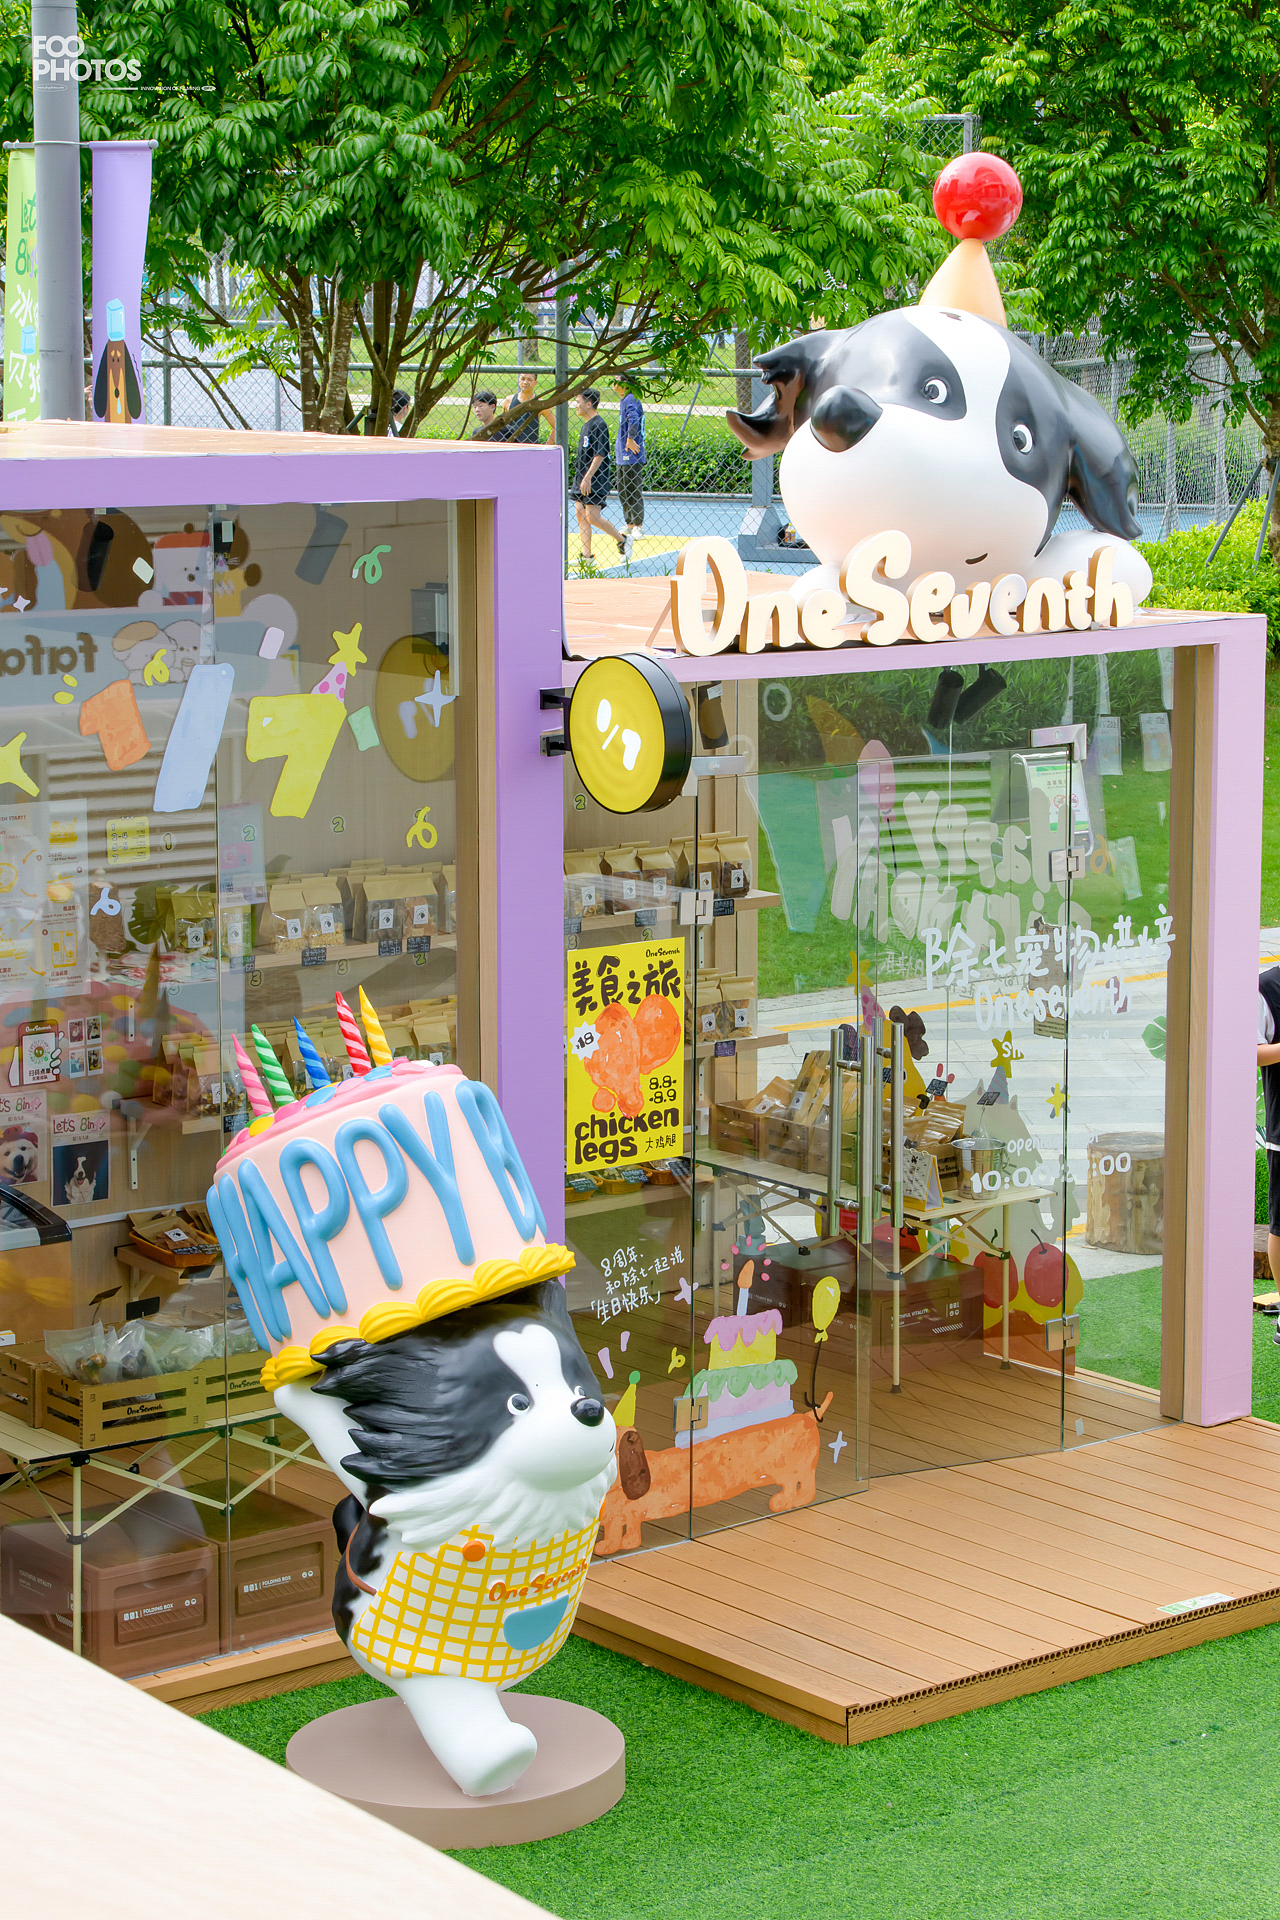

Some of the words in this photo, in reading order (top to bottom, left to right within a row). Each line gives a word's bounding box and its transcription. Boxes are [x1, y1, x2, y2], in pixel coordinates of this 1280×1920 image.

[332, 816, 345, 833] 2
[163, 833, 172, 850] 1
[243, 825, 256, 842] 2
[337, 959, 348, 975] 3
[250, 970, 262, 987] 3
[572, 955, 681, 1016] 美食之旅
[574, 1107, 680, 1141] chicken
[575, 1136, 638, 1165] legs
[206, 1091, 476, 1351] HAPPY
[262, 1577, 281, 1586] FOLDING
[143, 1604, 164, 1614] FOLDING
